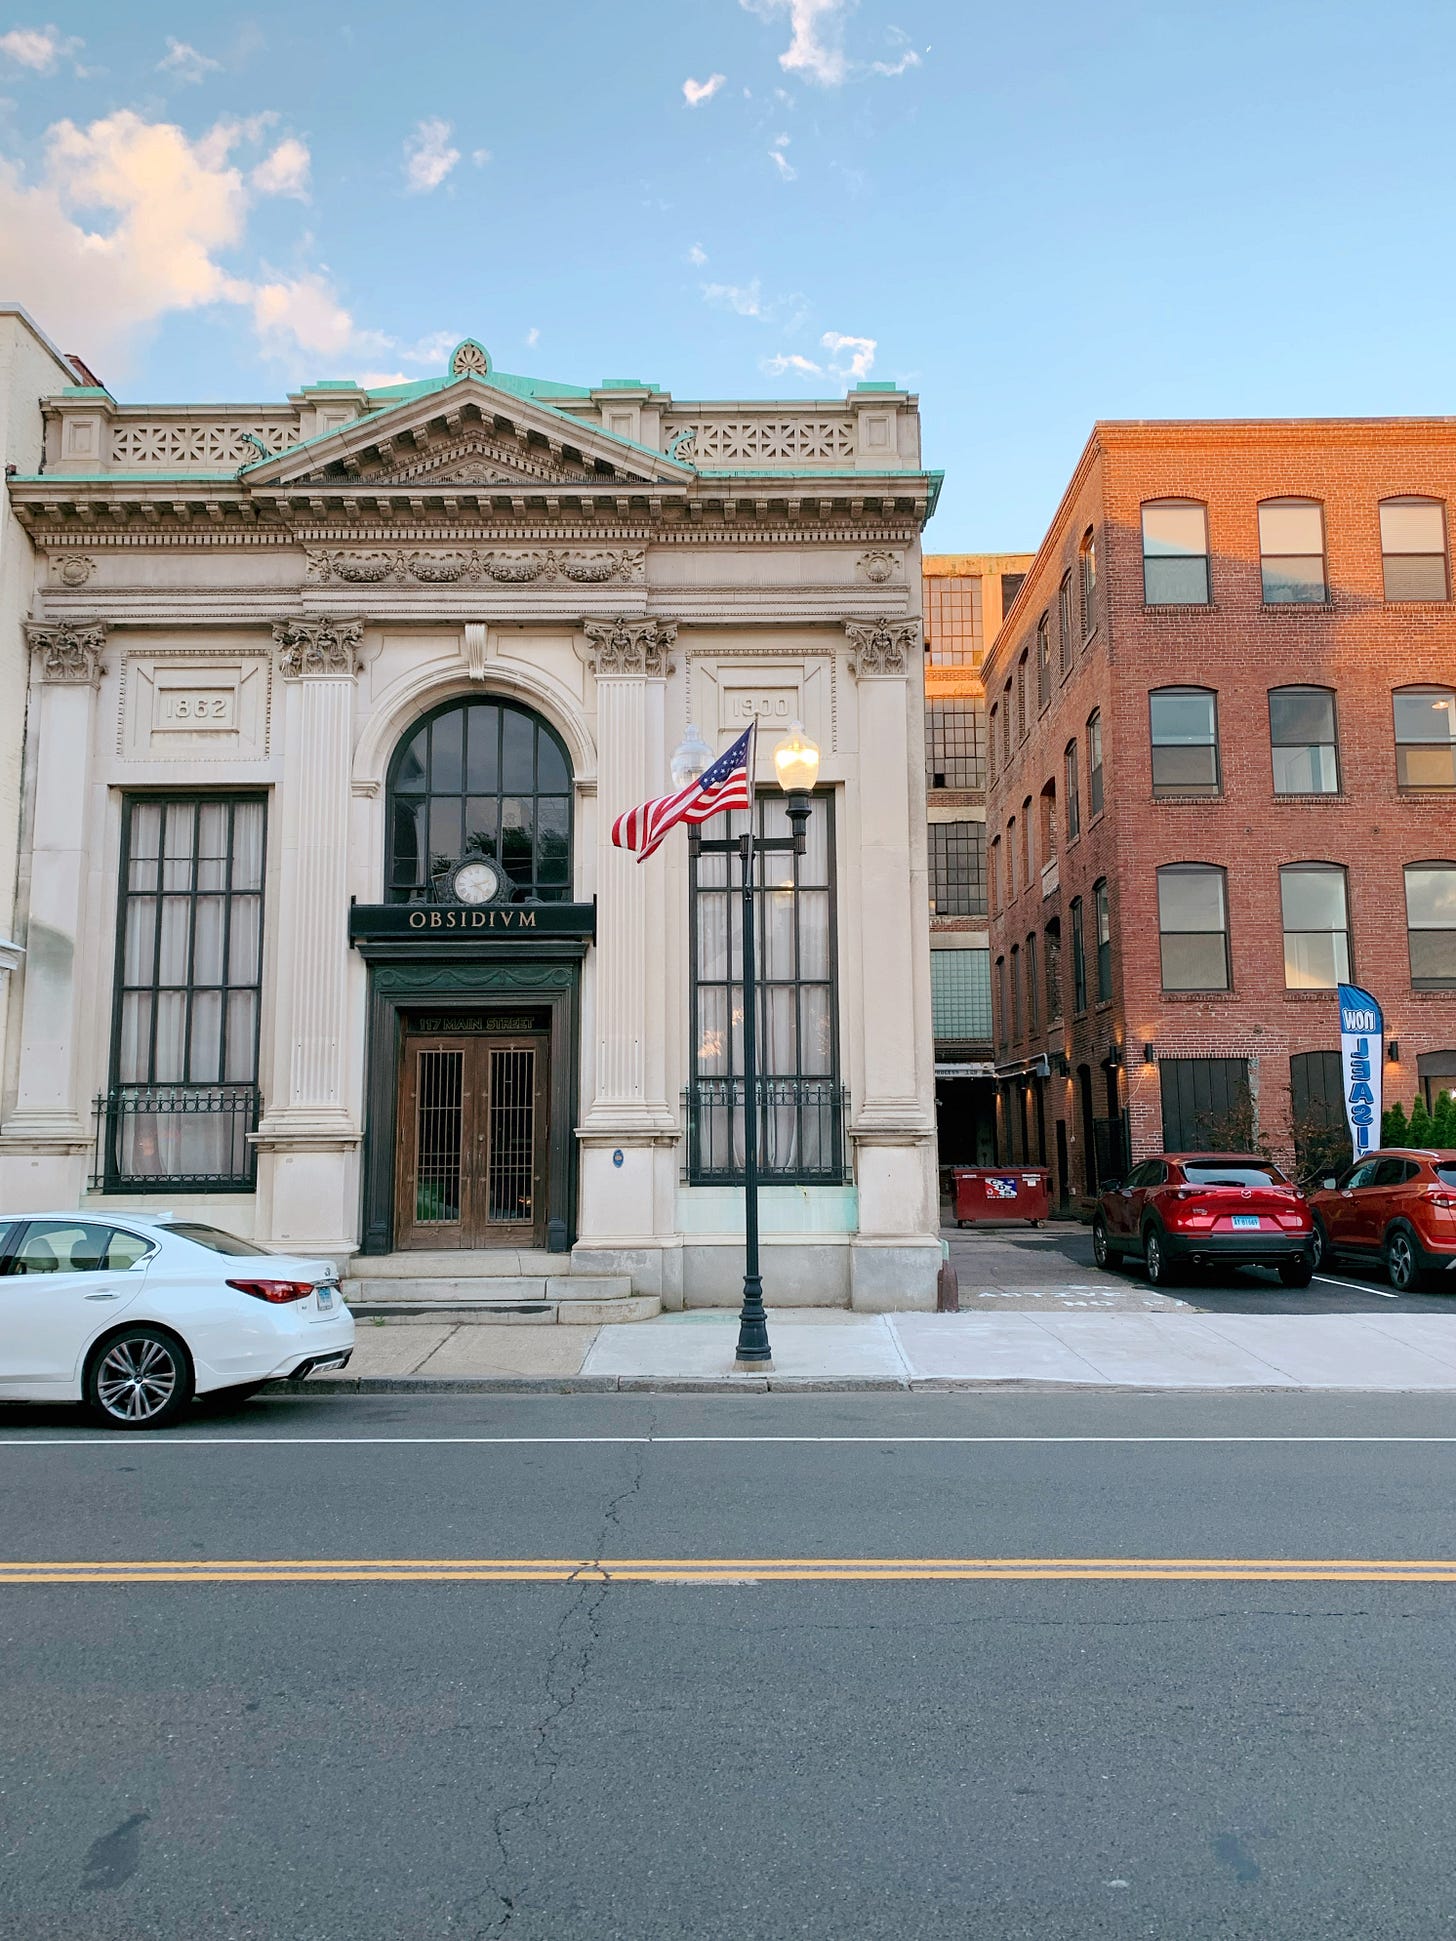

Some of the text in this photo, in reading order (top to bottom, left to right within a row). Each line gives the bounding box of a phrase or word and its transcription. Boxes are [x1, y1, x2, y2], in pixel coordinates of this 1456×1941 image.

[166, 698, 226, 718] 1862
[733, 698, 789, 717] 1900
[409, 911, 537, 928] OBSIDIVM
[420, 1017, 535, 1031] 117 MAIN STREET
